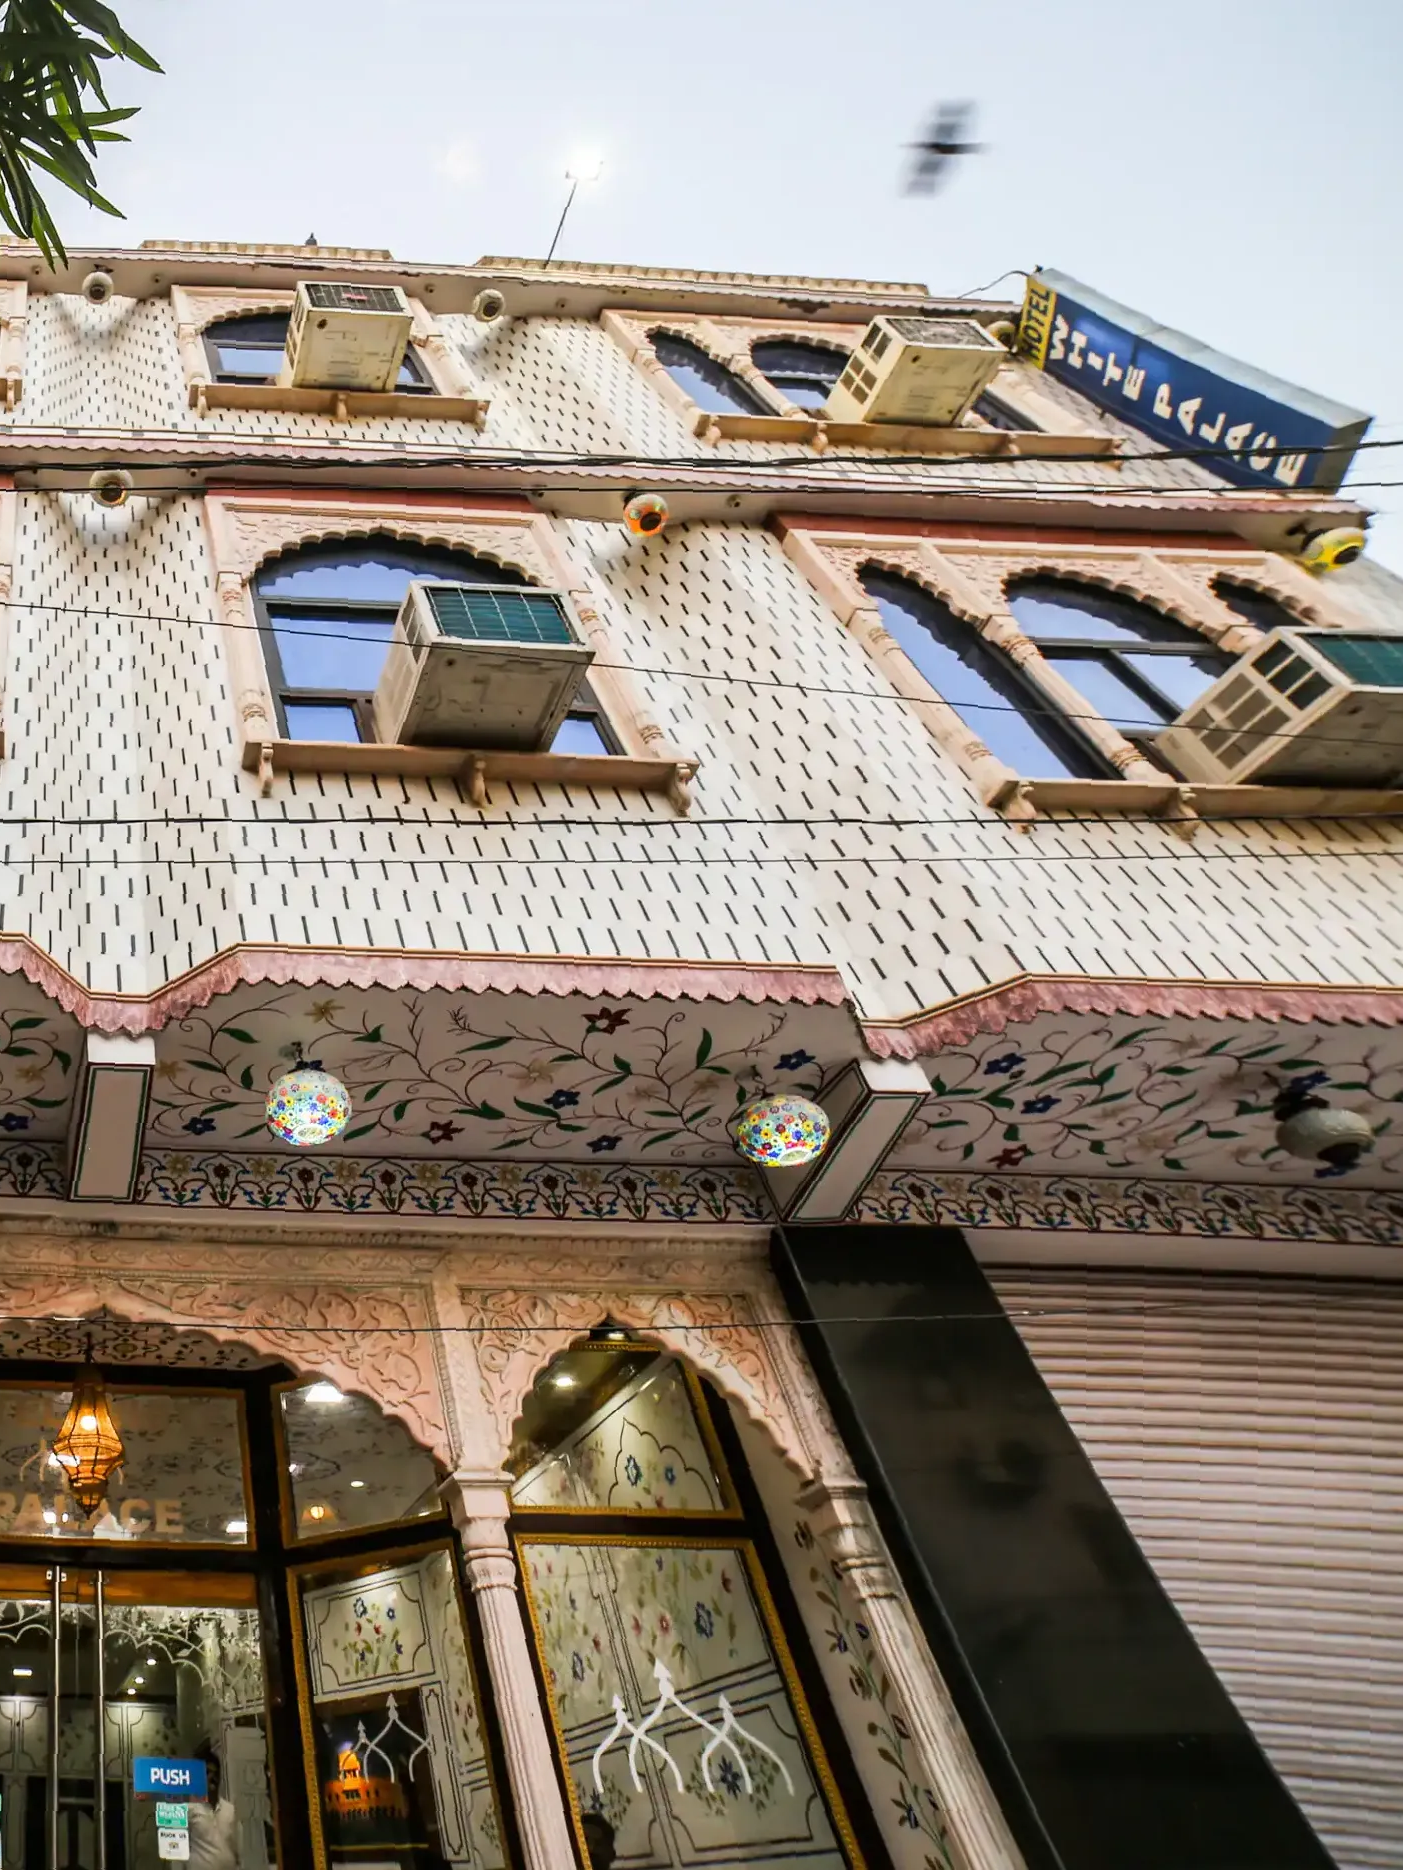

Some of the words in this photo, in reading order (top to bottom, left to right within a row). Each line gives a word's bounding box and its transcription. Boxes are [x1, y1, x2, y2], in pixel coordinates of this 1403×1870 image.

[1021, 288, 1050, 361] HOTEL
[1049, 314, 1146, 401] WHITE
[1153, 383, 1307, 487] PALACE
[150, 1767, 190, 1786] PUSH
